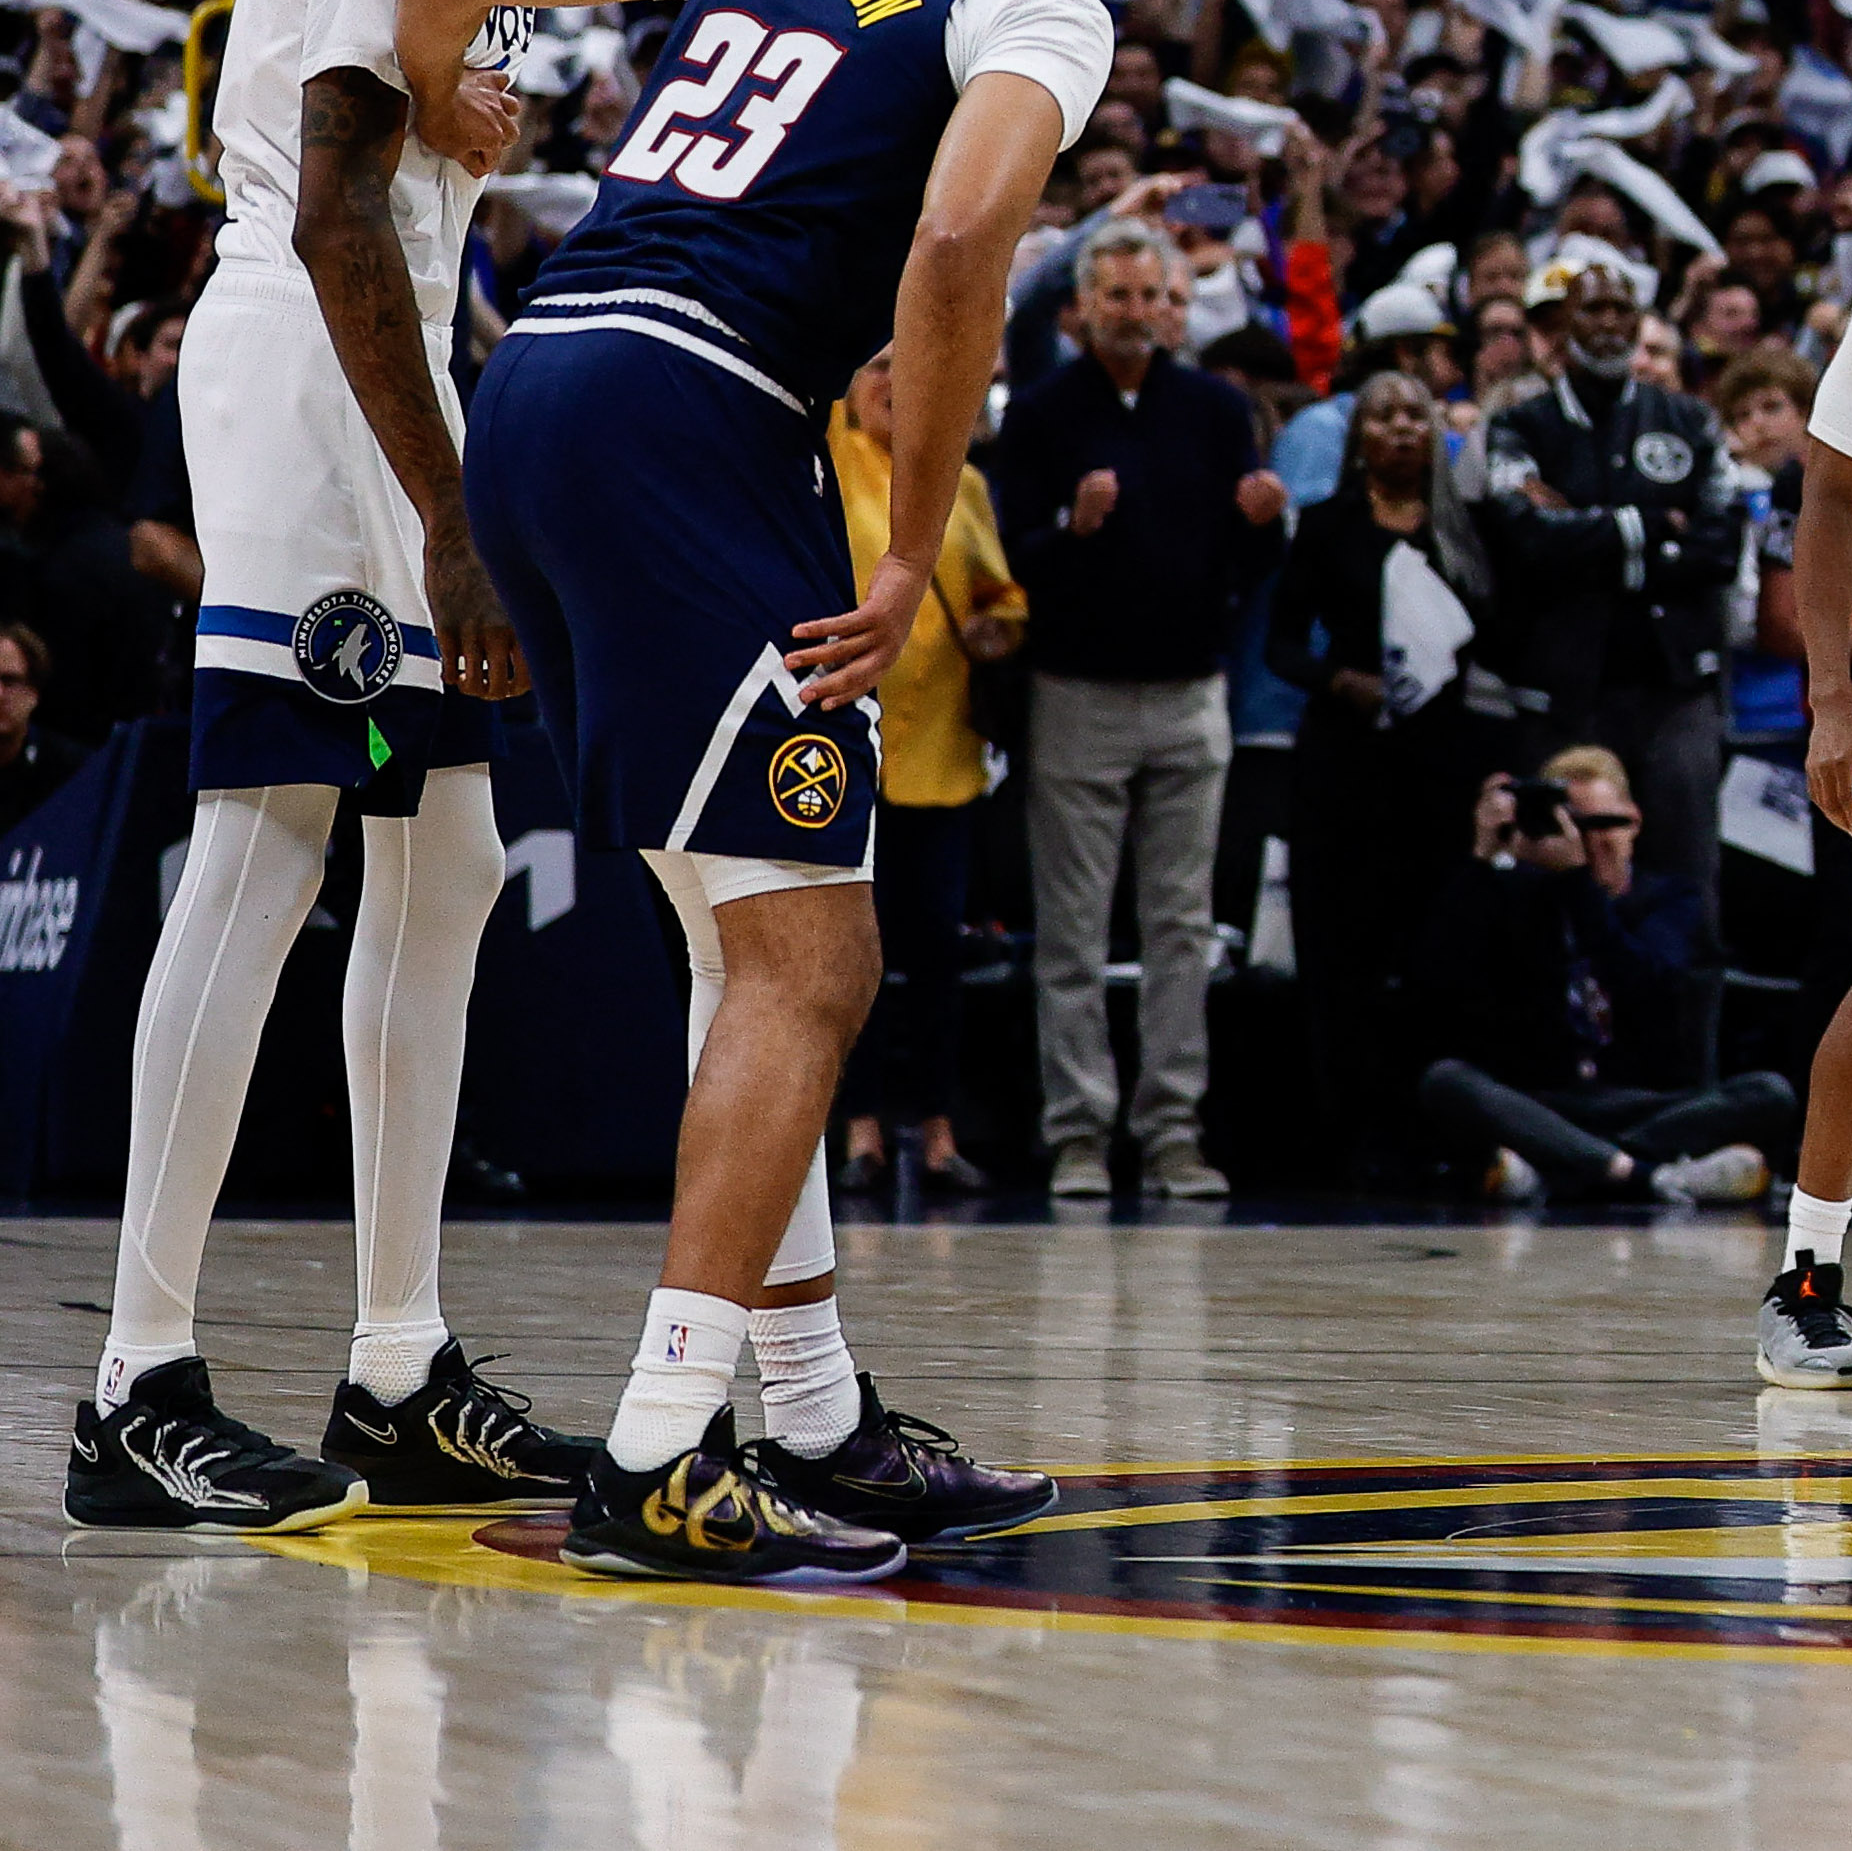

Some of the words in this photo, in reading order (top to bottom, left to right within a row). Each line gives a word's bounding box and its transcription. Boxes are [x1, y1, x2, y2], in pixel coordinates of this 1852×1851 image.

[602, 8, 849, 202] 23
[297, 595, 347, 659] MINNESOTA
[352, 594, 399, 685] TIMBERWOLVES
